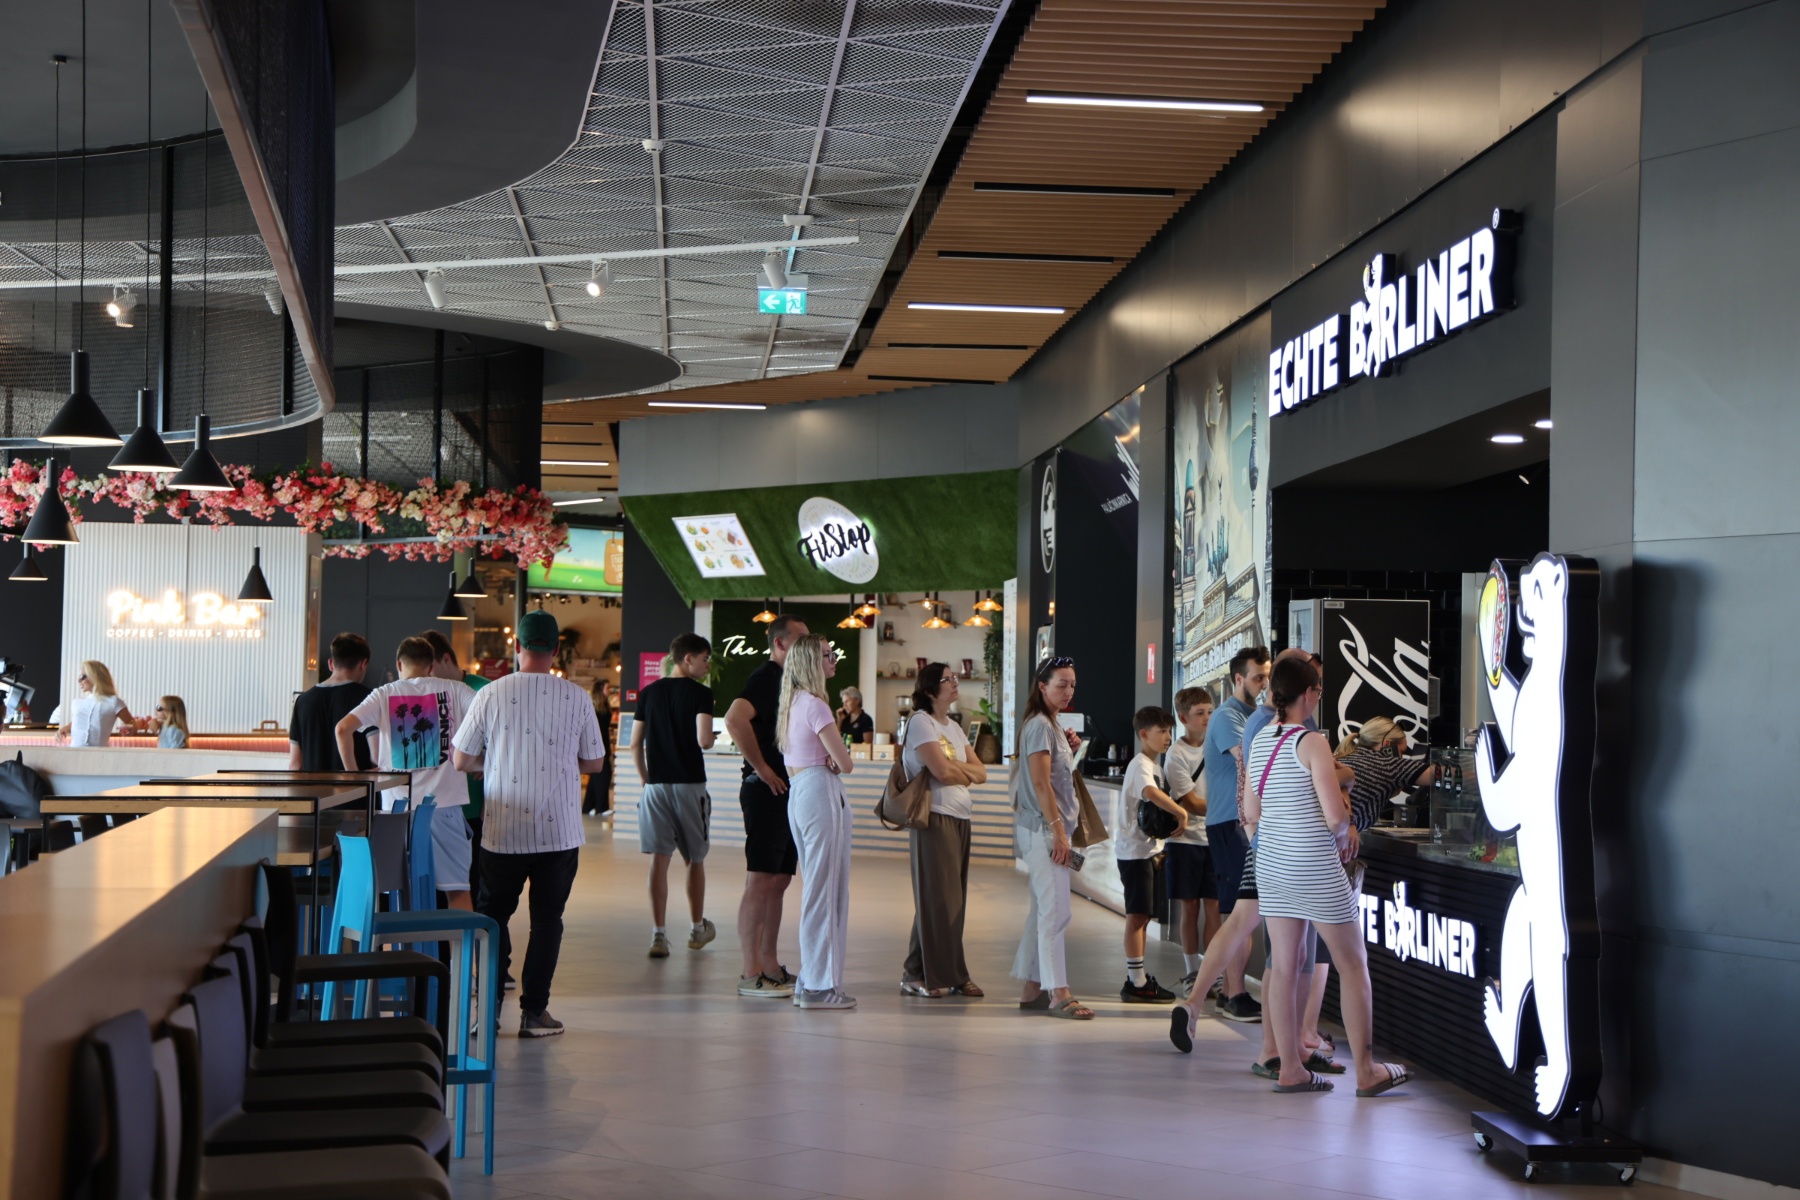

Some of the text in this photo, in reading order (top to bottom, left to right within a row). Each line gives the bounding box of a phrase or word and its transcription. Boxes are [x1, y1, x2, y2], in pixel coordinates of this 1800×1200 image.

[1269, 227, 1494, 417] ECHTE BRLINER
[797, 522, 871, 571] FitStop
[107, 589, 260, 625] Pink Bar
[106, 628, 261, 638] COFFEE DRINKS BITES
[722, 635, 758, 657] The
[437, 691, 450, 765] VENICE
[1384, 881, 1475, 978] BRLINER
